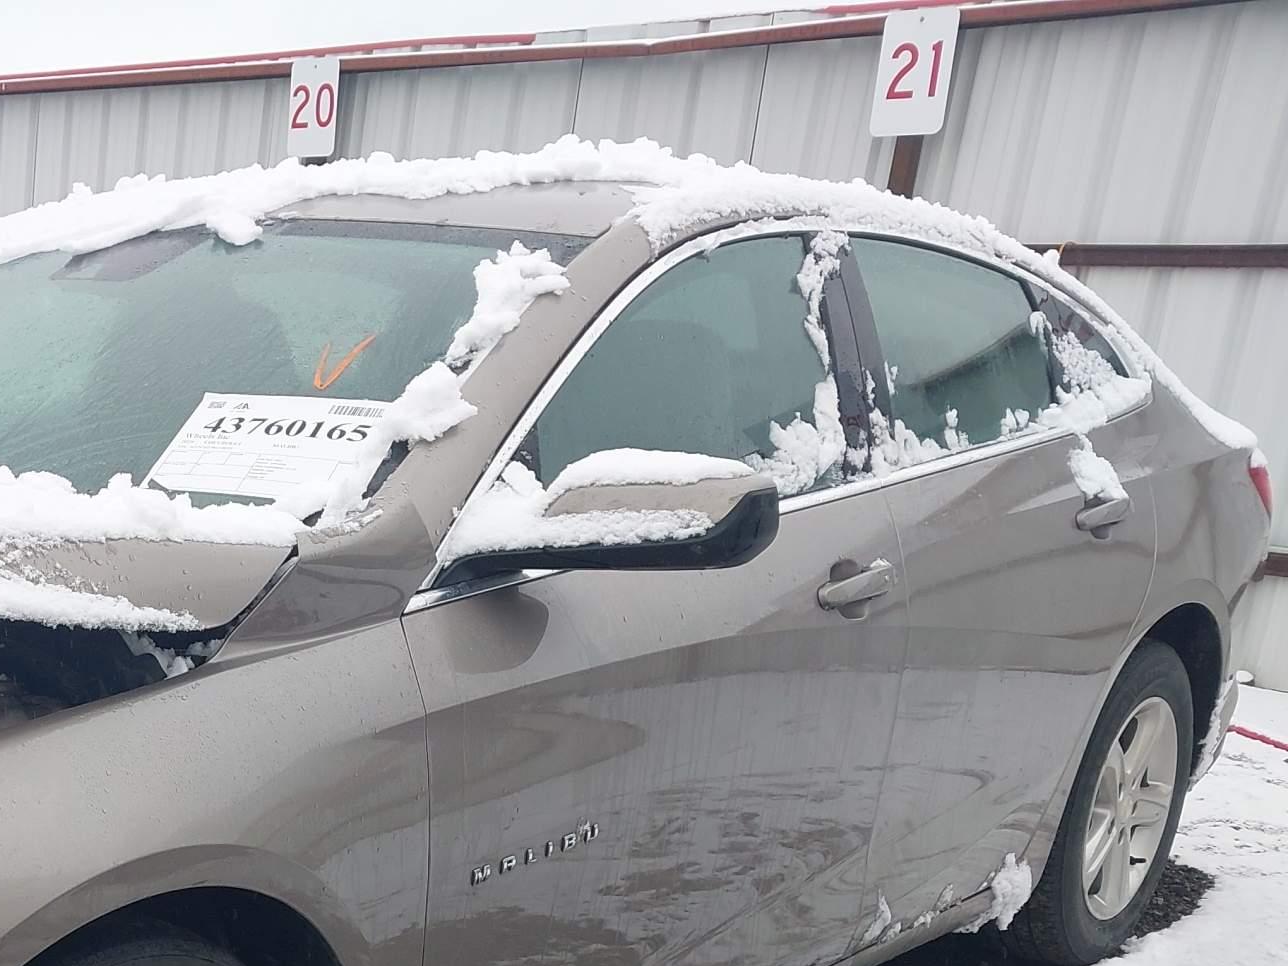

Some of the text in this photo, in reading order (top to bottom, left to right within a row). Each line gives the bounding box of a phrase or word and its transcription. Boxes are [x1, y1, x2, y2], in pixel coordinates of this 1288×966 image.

[885, 40, 944, 100] 21
[291, 83, 335, 129] 20
[203, 416, 372, 442] 43760165
[470, 823, 600, 887] MALIBU
